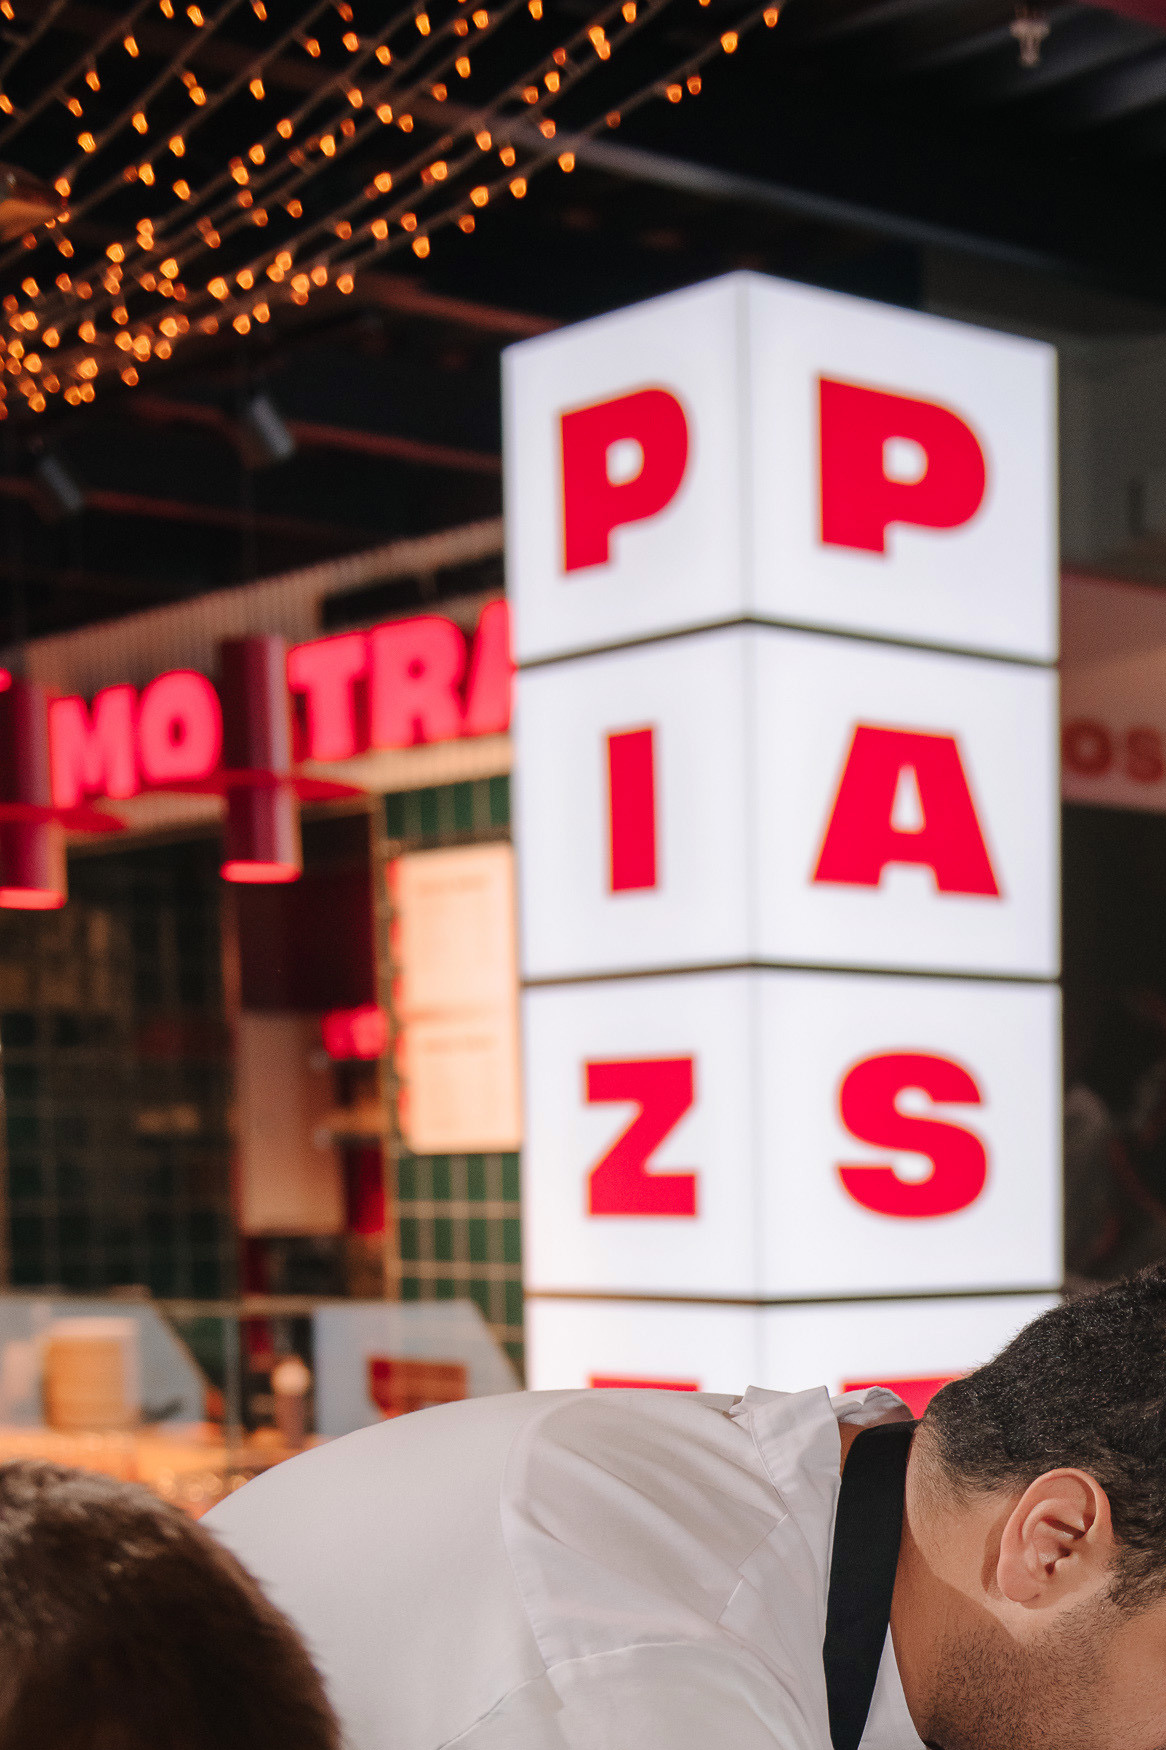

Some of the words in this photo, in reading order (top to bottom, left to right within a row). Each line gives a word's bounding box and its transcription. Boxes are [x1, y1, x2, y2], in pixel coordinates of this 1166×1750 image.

[49, 599, 514, 809] MOTR
[559, 386, 699, 1393] PIZ
[811, 374, 1002, 1420] PAS
